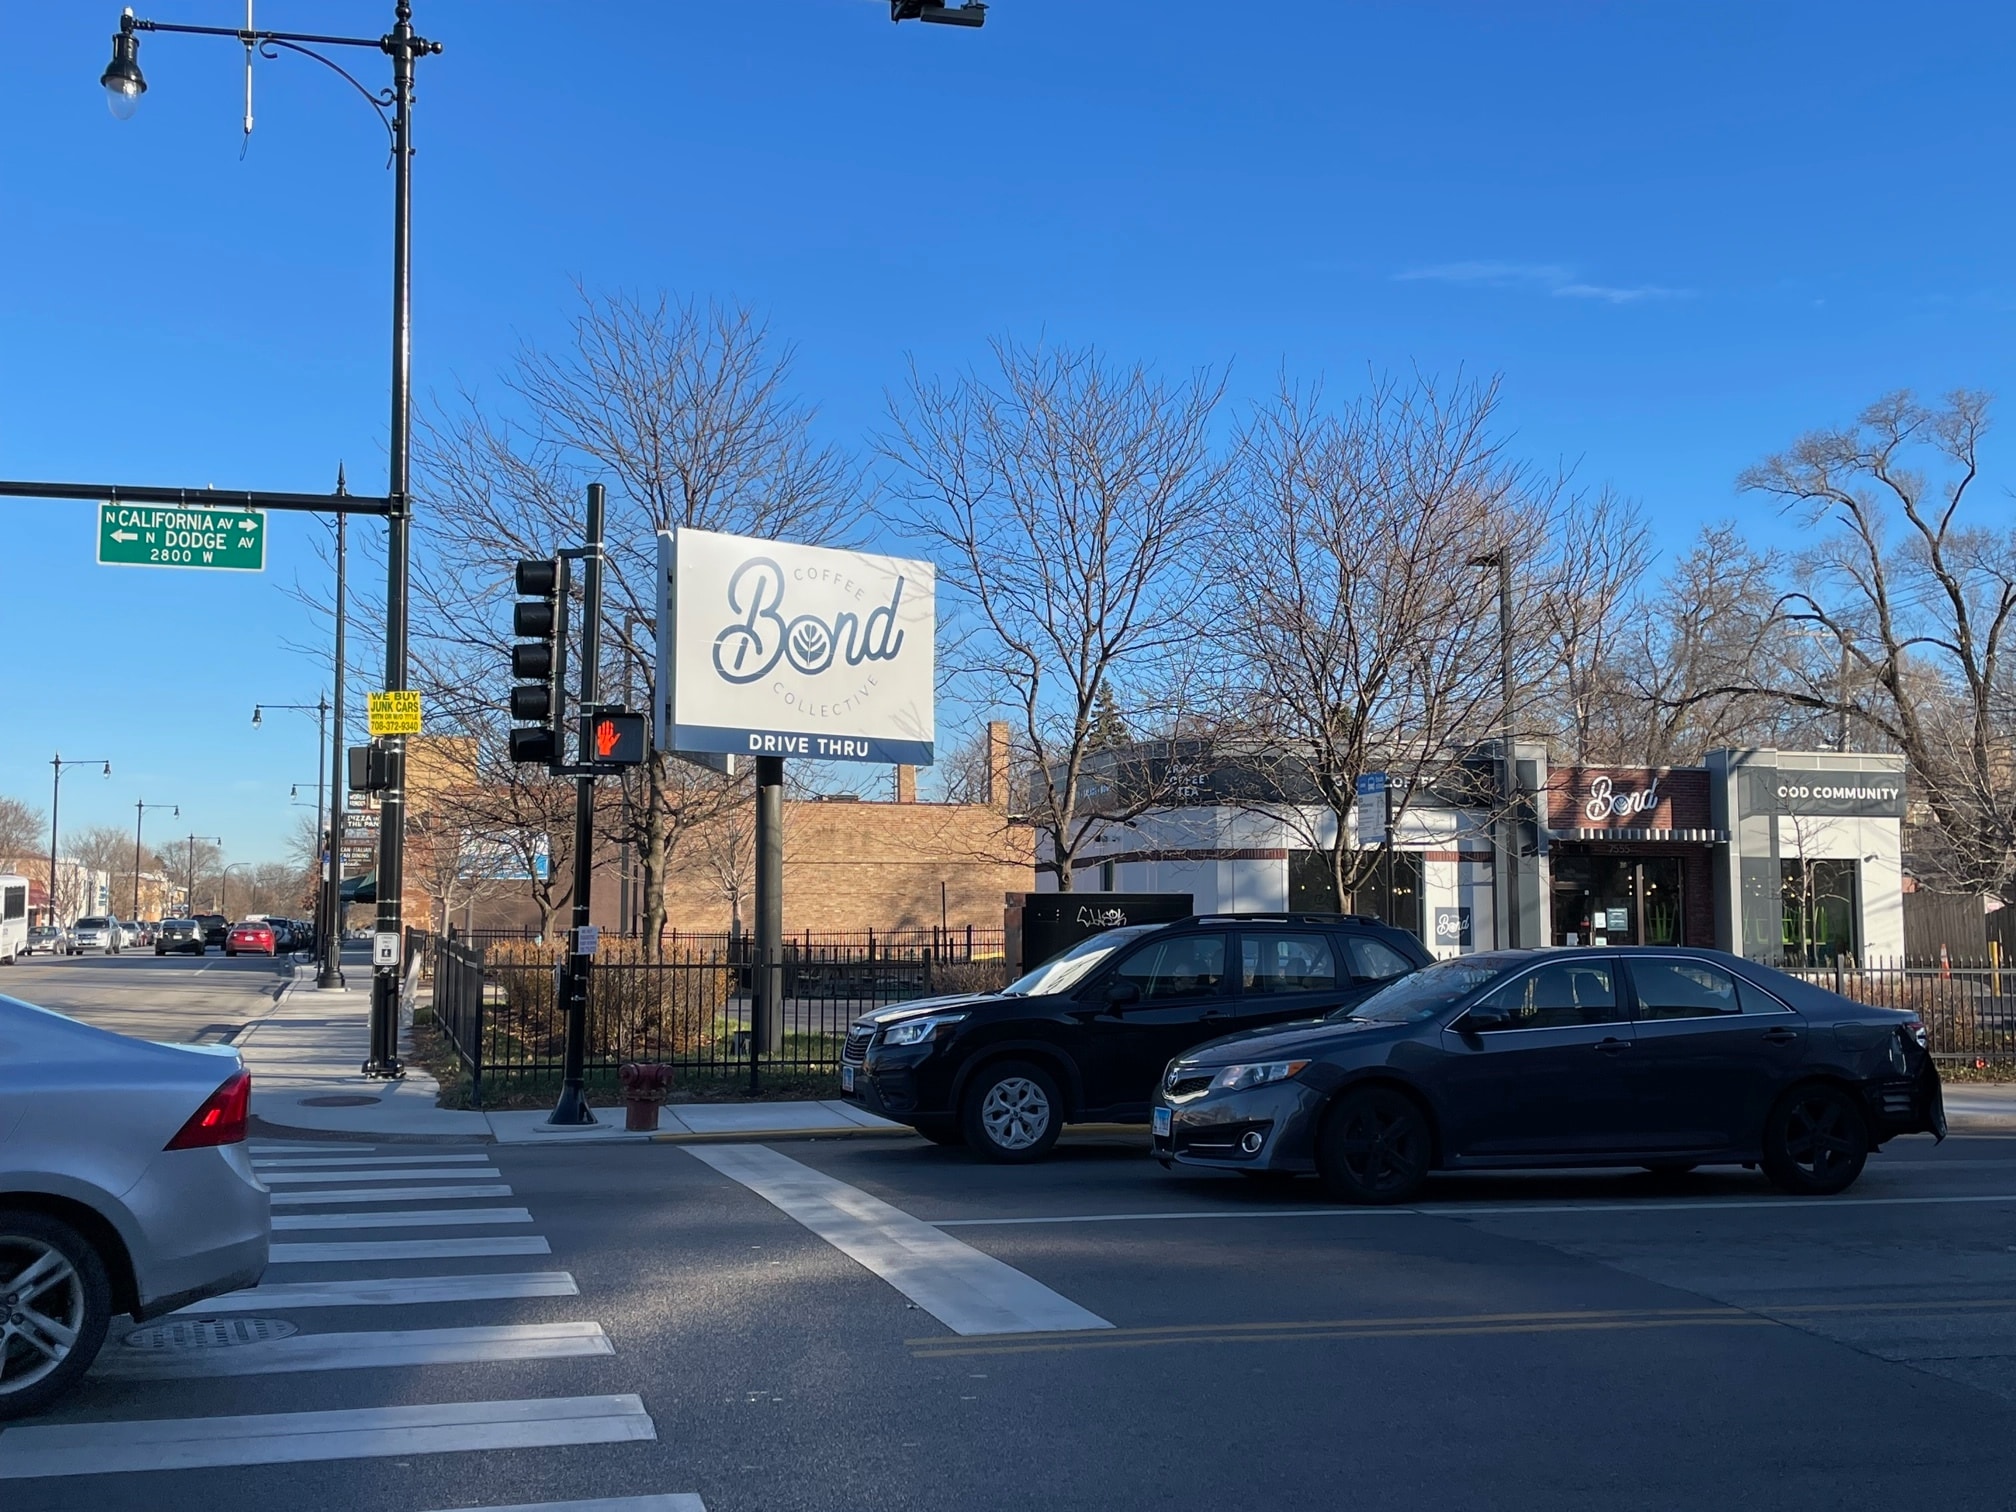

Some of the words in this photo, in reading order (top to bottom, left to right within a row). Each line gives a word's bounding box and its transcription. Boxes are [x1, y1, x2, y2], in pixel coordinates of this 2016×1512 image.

[106, 512, 115, 523] N
[118, 510, 214, 531] CALIFORNIA
[217, 518, 234, 530] AV
[146, 532, 155, 543] N
[165, 531, 227, 550] DODGE
[238, 537, 254, 549] AV
[151, 548, 192, 562] 2800
[203, 551, 213, 563] W
[794, 567, 865, 601] COFFEE
[712, 556, 905, 685] Bond
[371, 692, 389, 700] WE
[394, 692, 418, 701] BUY
[371, 701, 393, 712] JUNK
[396, 701, 418, 712] CARS
[772, 674, 879, 718] COLLECTIVE
[750, 733, 809, 753] DRIVE
[817, 738, 869, 757] THRU
[1585, 776, 1659, 821] Bond
[1813, 787, 1899, 800] COMMUNITY
[1437, 913, 1469, 935] Bond
